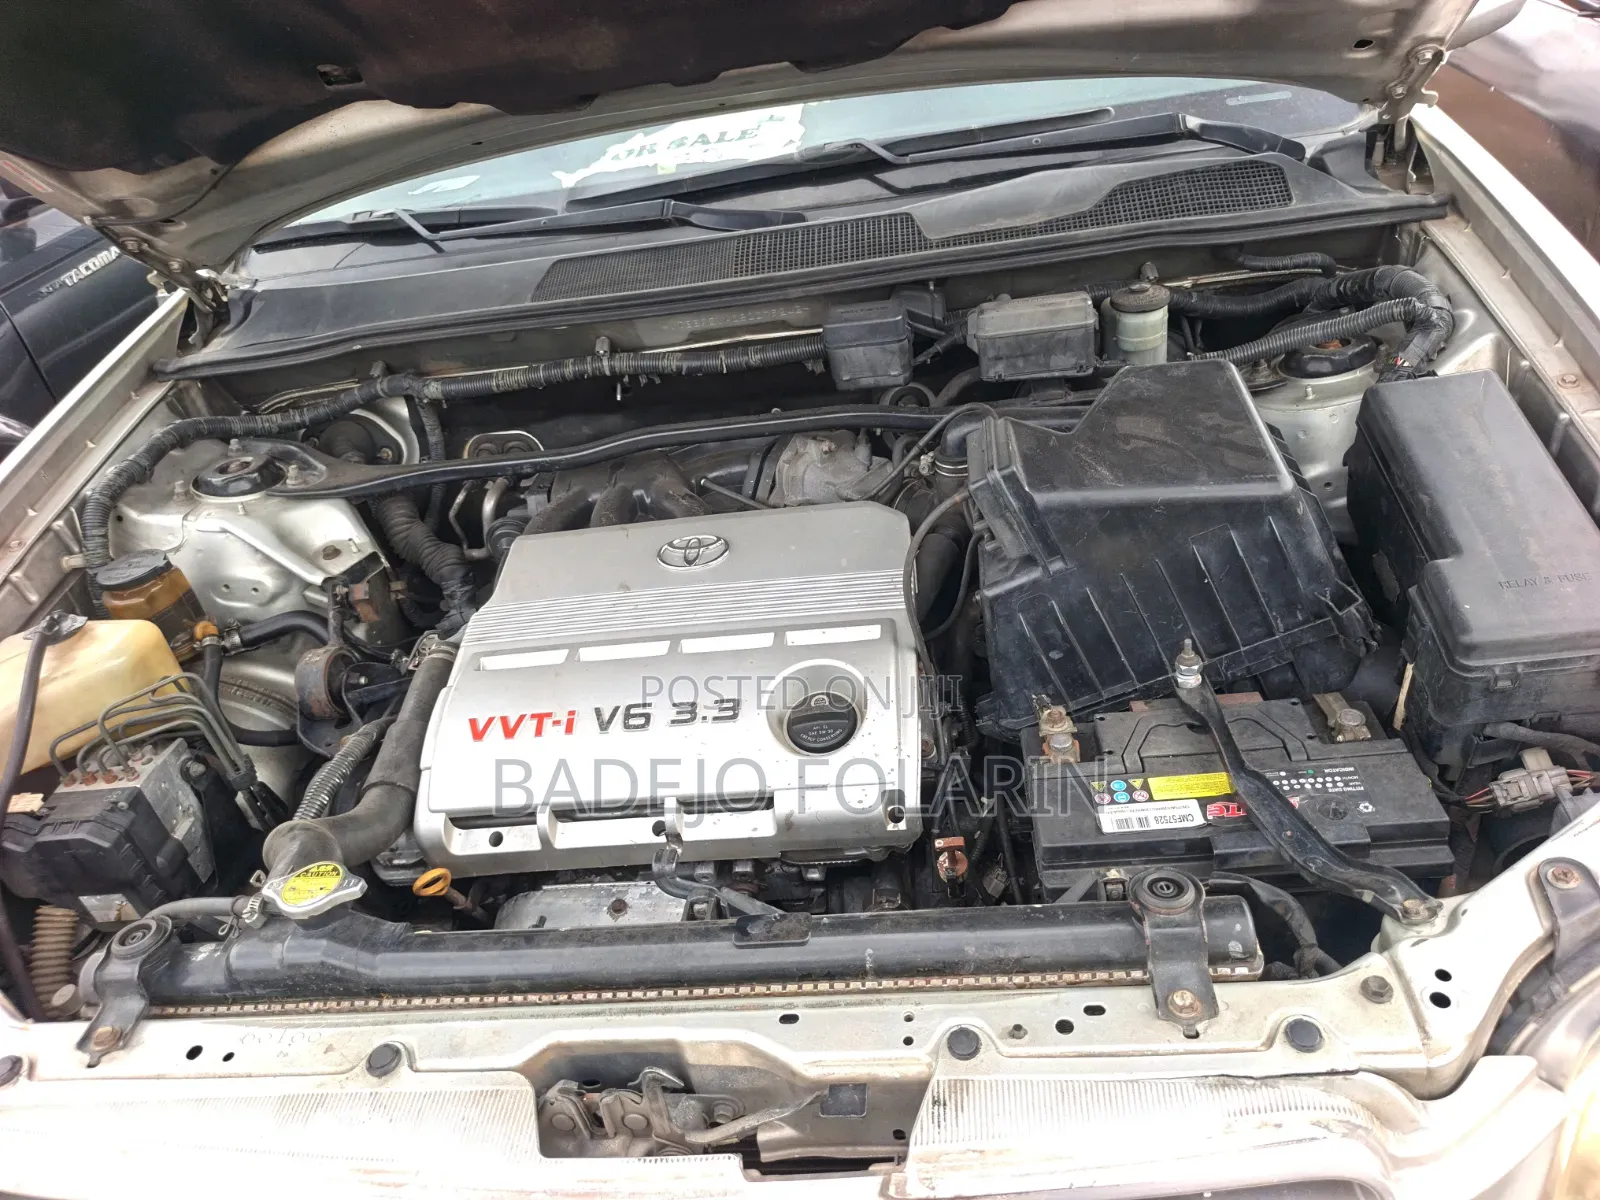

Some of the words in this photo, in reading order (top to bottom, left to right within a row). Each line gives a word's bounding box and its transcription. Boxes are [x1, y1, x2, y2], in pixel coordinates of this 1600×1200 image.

[60, 245, 120, 287] TACOMA
[1498, 578, 1538, 590] RELAY
[1557, 571, 1592, 584] FUSE
[468, 708, 578, 743] VVT-i
[593, 701, 654, 735] V6
[667, 697, 743, 728] 3.3
[1153, 813, 1195, 826] CMF57528
[300, 870, 339, 878] CAUTION
